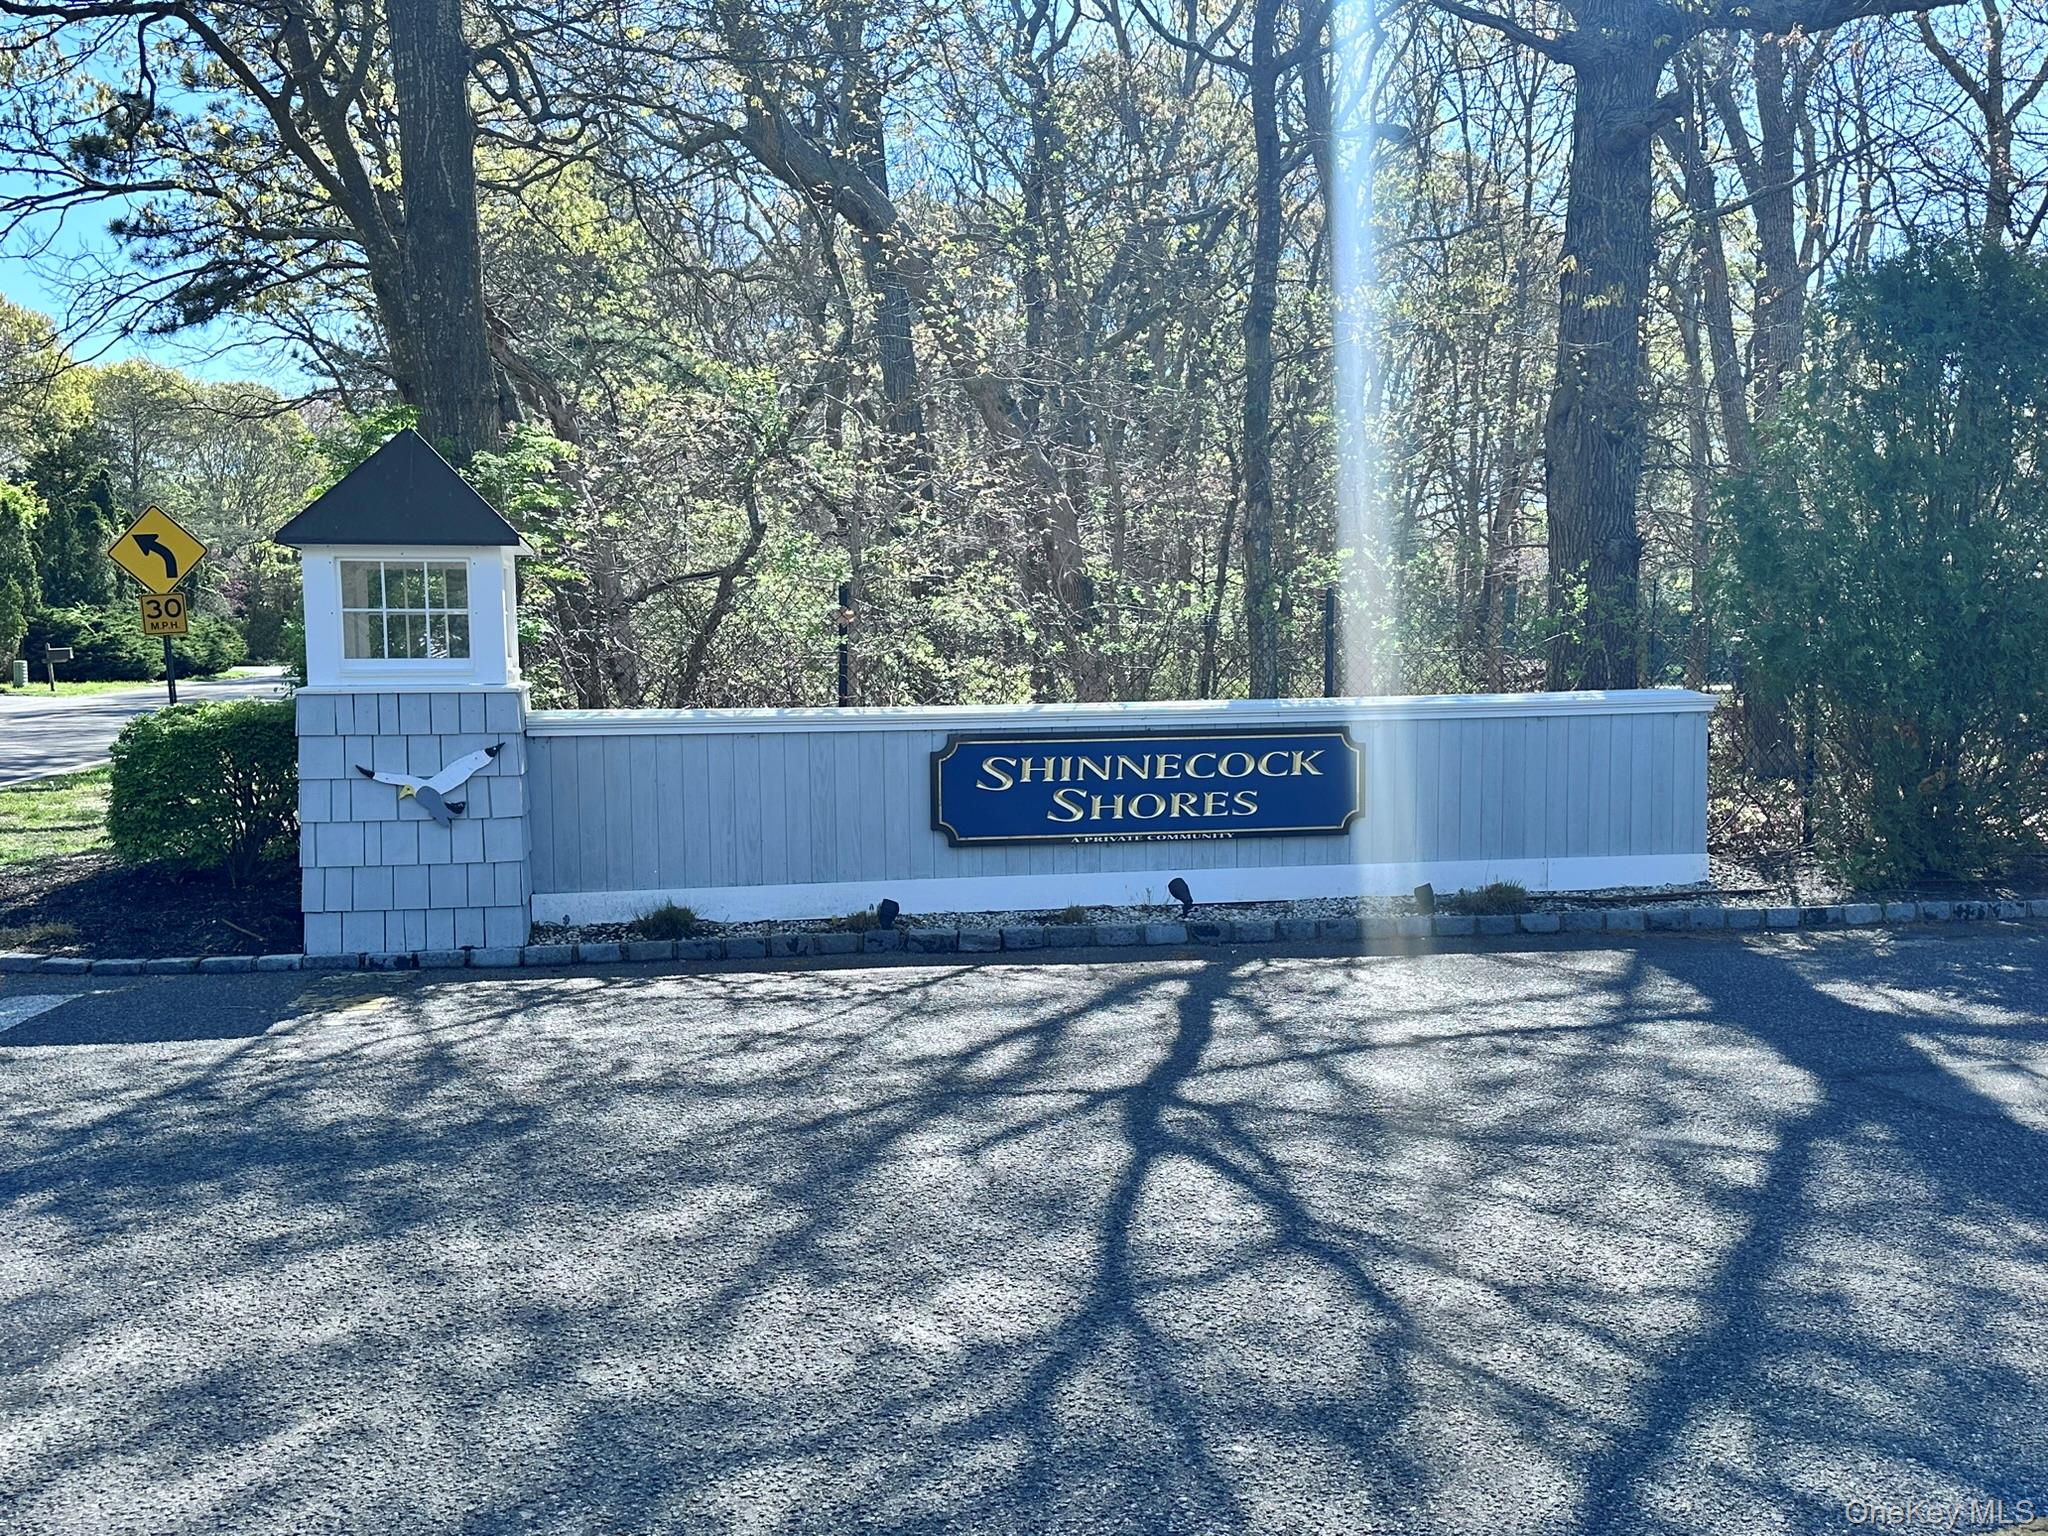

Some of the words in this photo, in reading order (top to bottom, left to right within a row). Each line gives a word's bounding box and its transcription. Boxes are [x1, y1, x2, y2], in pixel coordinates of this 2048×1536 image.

[146, 598, 182, 619] 30
[976, 750, 1326, 791] SHINNECOCK
[1047, 789, 1258, 823] SHORES
[1084, 835, 1143, 843] PRIVATE
[1147, 832, 1235, 841] COMMUNITY
